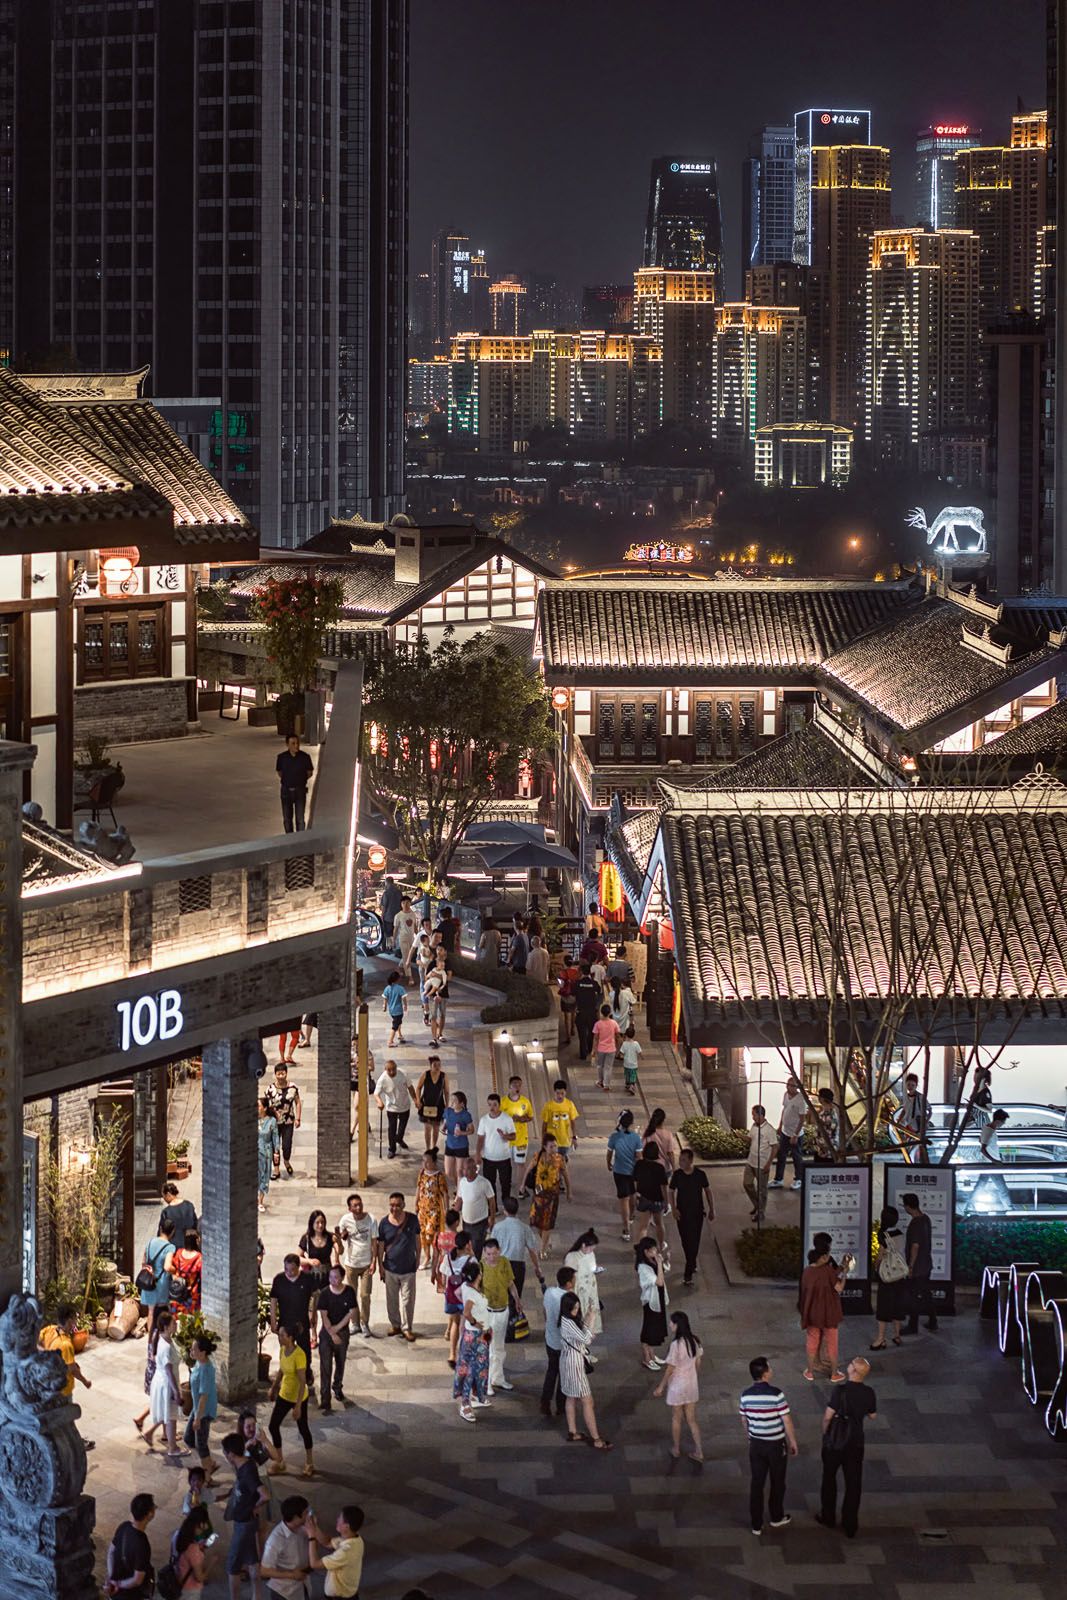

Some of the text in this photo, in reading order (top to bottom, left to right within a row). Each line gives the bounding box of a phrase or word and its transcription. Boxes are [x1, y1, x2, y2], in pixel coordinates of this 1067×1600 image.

[832, 114, 860, 124] 中国银行
[117, 990, 183, 1051] 10B
[831, 1174, 860, 1182] 美食指南
[905, 1174, 937, 1182] 美食指南
